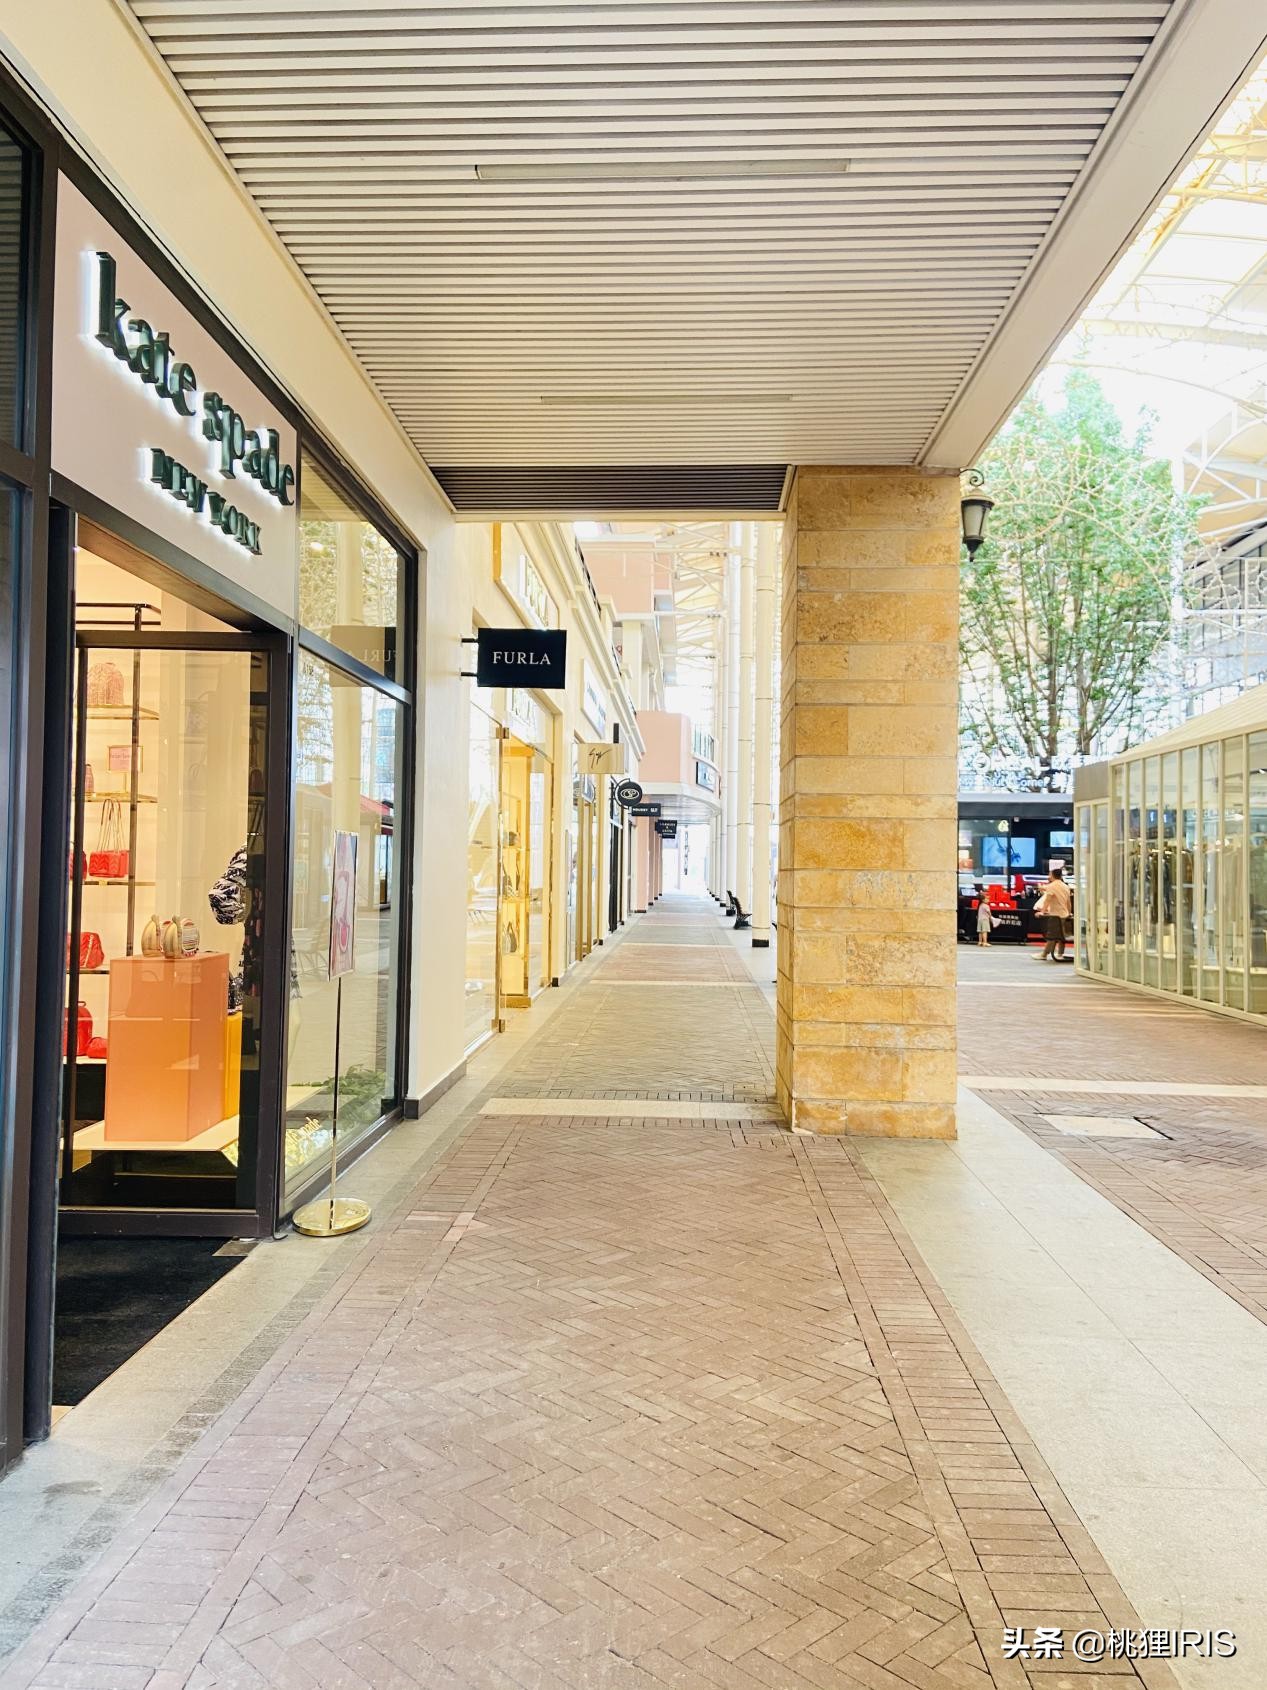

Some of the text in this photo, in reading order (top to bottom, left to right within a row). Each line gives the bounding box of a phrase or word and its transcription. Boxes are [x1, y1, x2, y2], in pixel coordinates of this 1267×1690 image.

[96, 251, 295, 506] kate spade
[208, 491, 263, 556] YORK
[493, 651, 551, 665] FURLA
